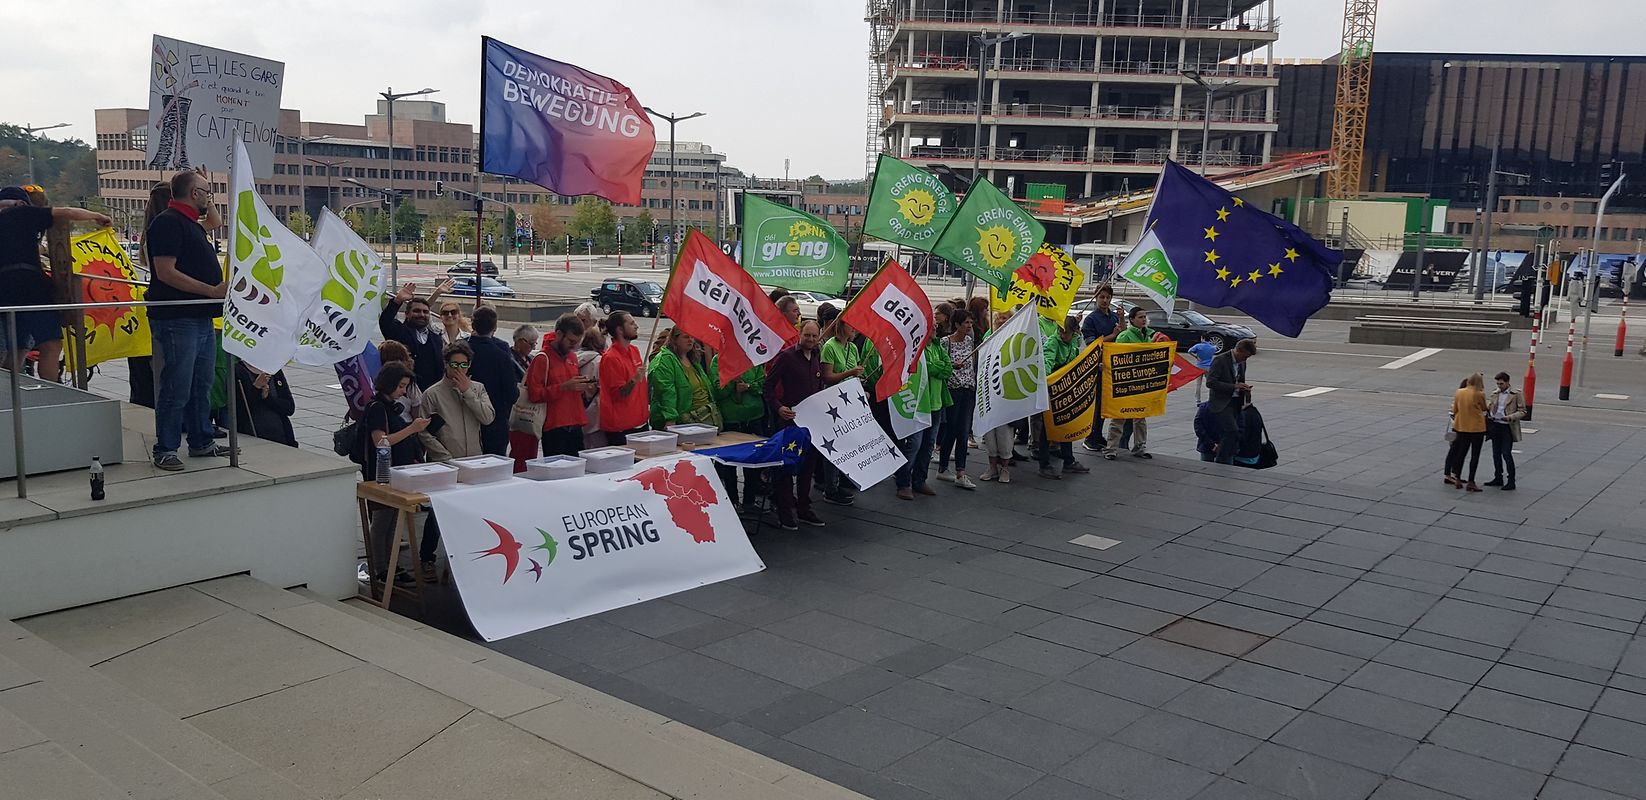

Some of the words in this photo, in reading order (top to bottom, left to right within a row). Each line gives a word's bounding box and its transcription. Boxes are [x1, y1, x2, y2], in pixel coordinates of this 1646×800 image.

[223, 59, 248, 78] LES
[503, 60, 618, 107] DEMOKRATIE
[216, 94, 250, 107] MOMENT
[503, 79, 641, 138] BEWEGUNG
[196, 113, 278, 148] CATTENOM
[890, 174, 922, 196] GRENG
[889, 218, 912, 239] GRAD
[976, 207, 1014, 225] GRENG
[1012, 216, 1034, 264] ENERGIE
[762, 236, 829, 262] gréng
[698, 279, 731, 305] déi
[884, 299, 914, 326] déi
[1113, 353, 1134, 366] Build
[1135, 355, 1140, 363] a
[1142, 350, 1167, 362] nuclear
[1051, 373, 1073, 396] Build
[1072, 371, 1077, 381] a
[1076, 350, 1101, 377] nuclear
[1114, 370, 1131, 380] free
[1132, 366, 1158, 379] Europe.
[1115, 386, 1127, 394] Stop
[1054, 394, 1073, 411] free
[832, 419, 858, 438] Hulot
[1056, 413, 1071, 423] Stop
[857, 458, 873, 471] pour
[562, 503, 649, 533] EUROPEAN
[568, 520, 661, 560] SPRING
